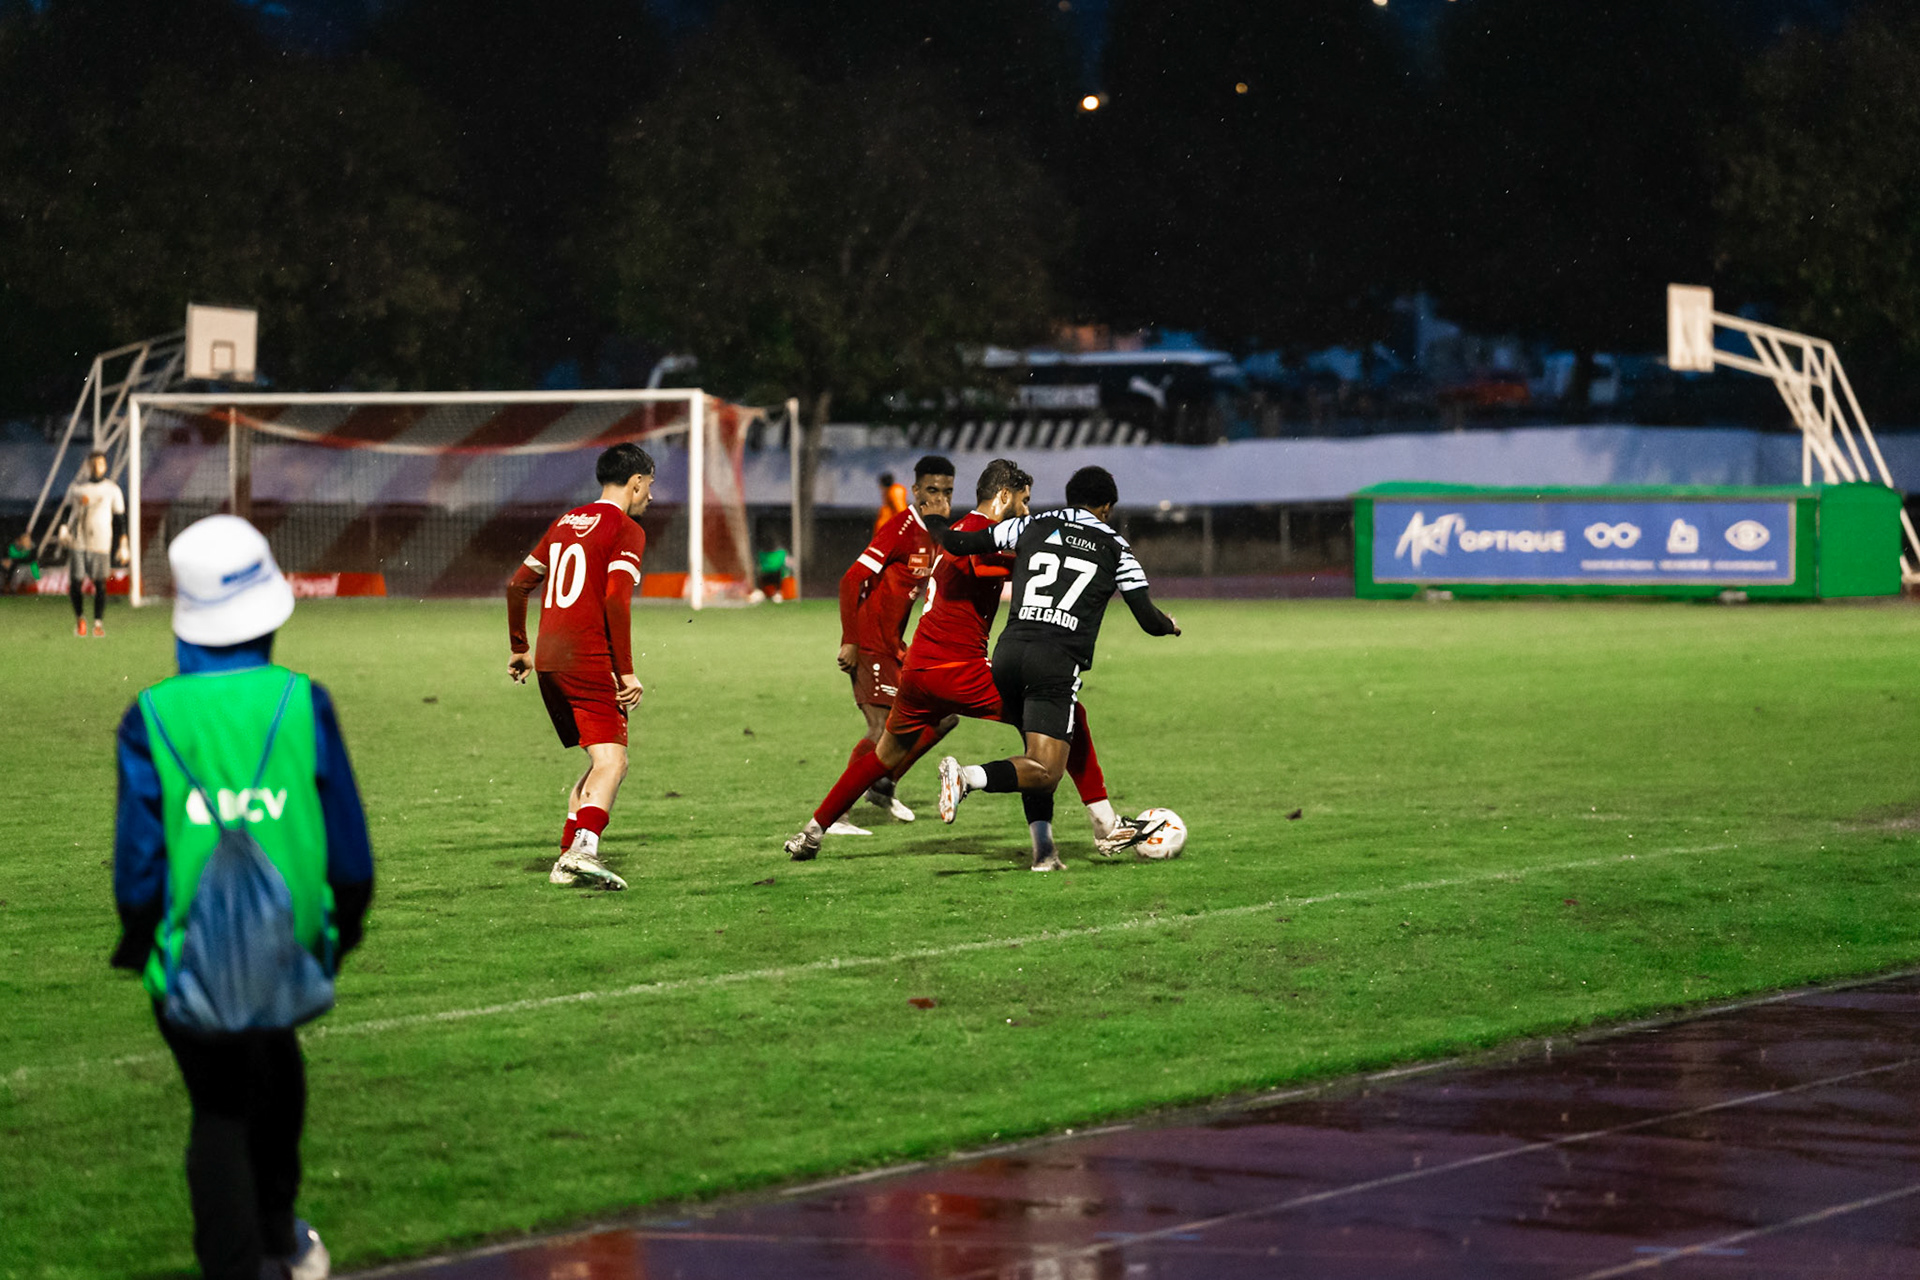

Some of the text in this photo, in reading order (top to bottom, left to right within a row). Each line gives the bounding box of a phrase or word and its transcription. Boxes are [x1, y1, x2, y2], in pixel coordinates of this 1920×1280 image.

[1065, 535, 1097, 552] CLIPAL
[1459, 530, 1566, 553] OPTIQUE
[544, 543, 587, 608] 10
[1022, 551, 1098, 612] 27
[1018, 606, 1079, 632] DELGADO
